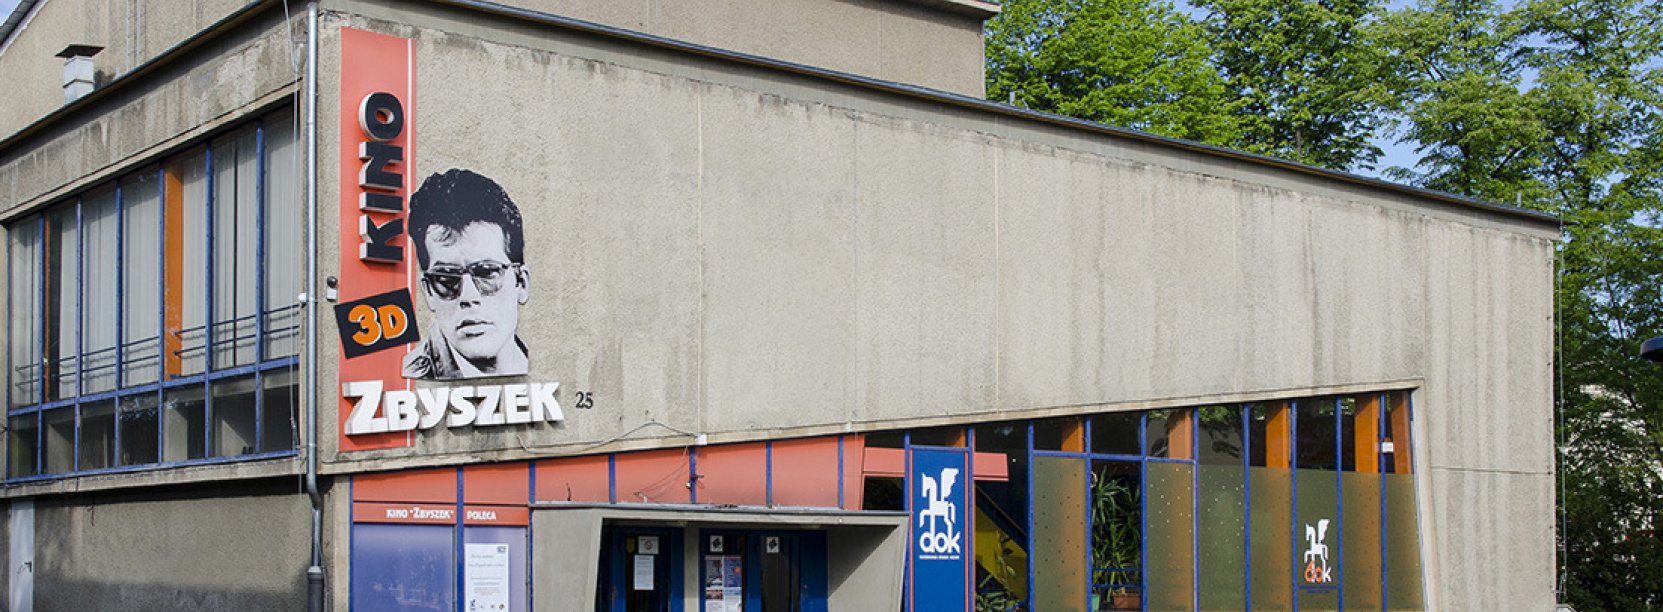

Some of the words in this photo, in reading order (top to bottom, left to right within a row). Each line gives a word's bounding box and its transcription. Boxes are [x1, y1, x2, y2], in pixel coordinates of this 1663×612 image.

[359, 91, 404, 263] KINO
[348, 304, 408, 346] 3D
[343, 380, 564, 435] ZBYSZEK
[575, 391, 594, 409] 25
[386, 509, 408, 518] KINO
[467, 511, 497, 520] POLECA
[919, 525, 961, 553] dok
[1304, 560, 1332, 583] dok
